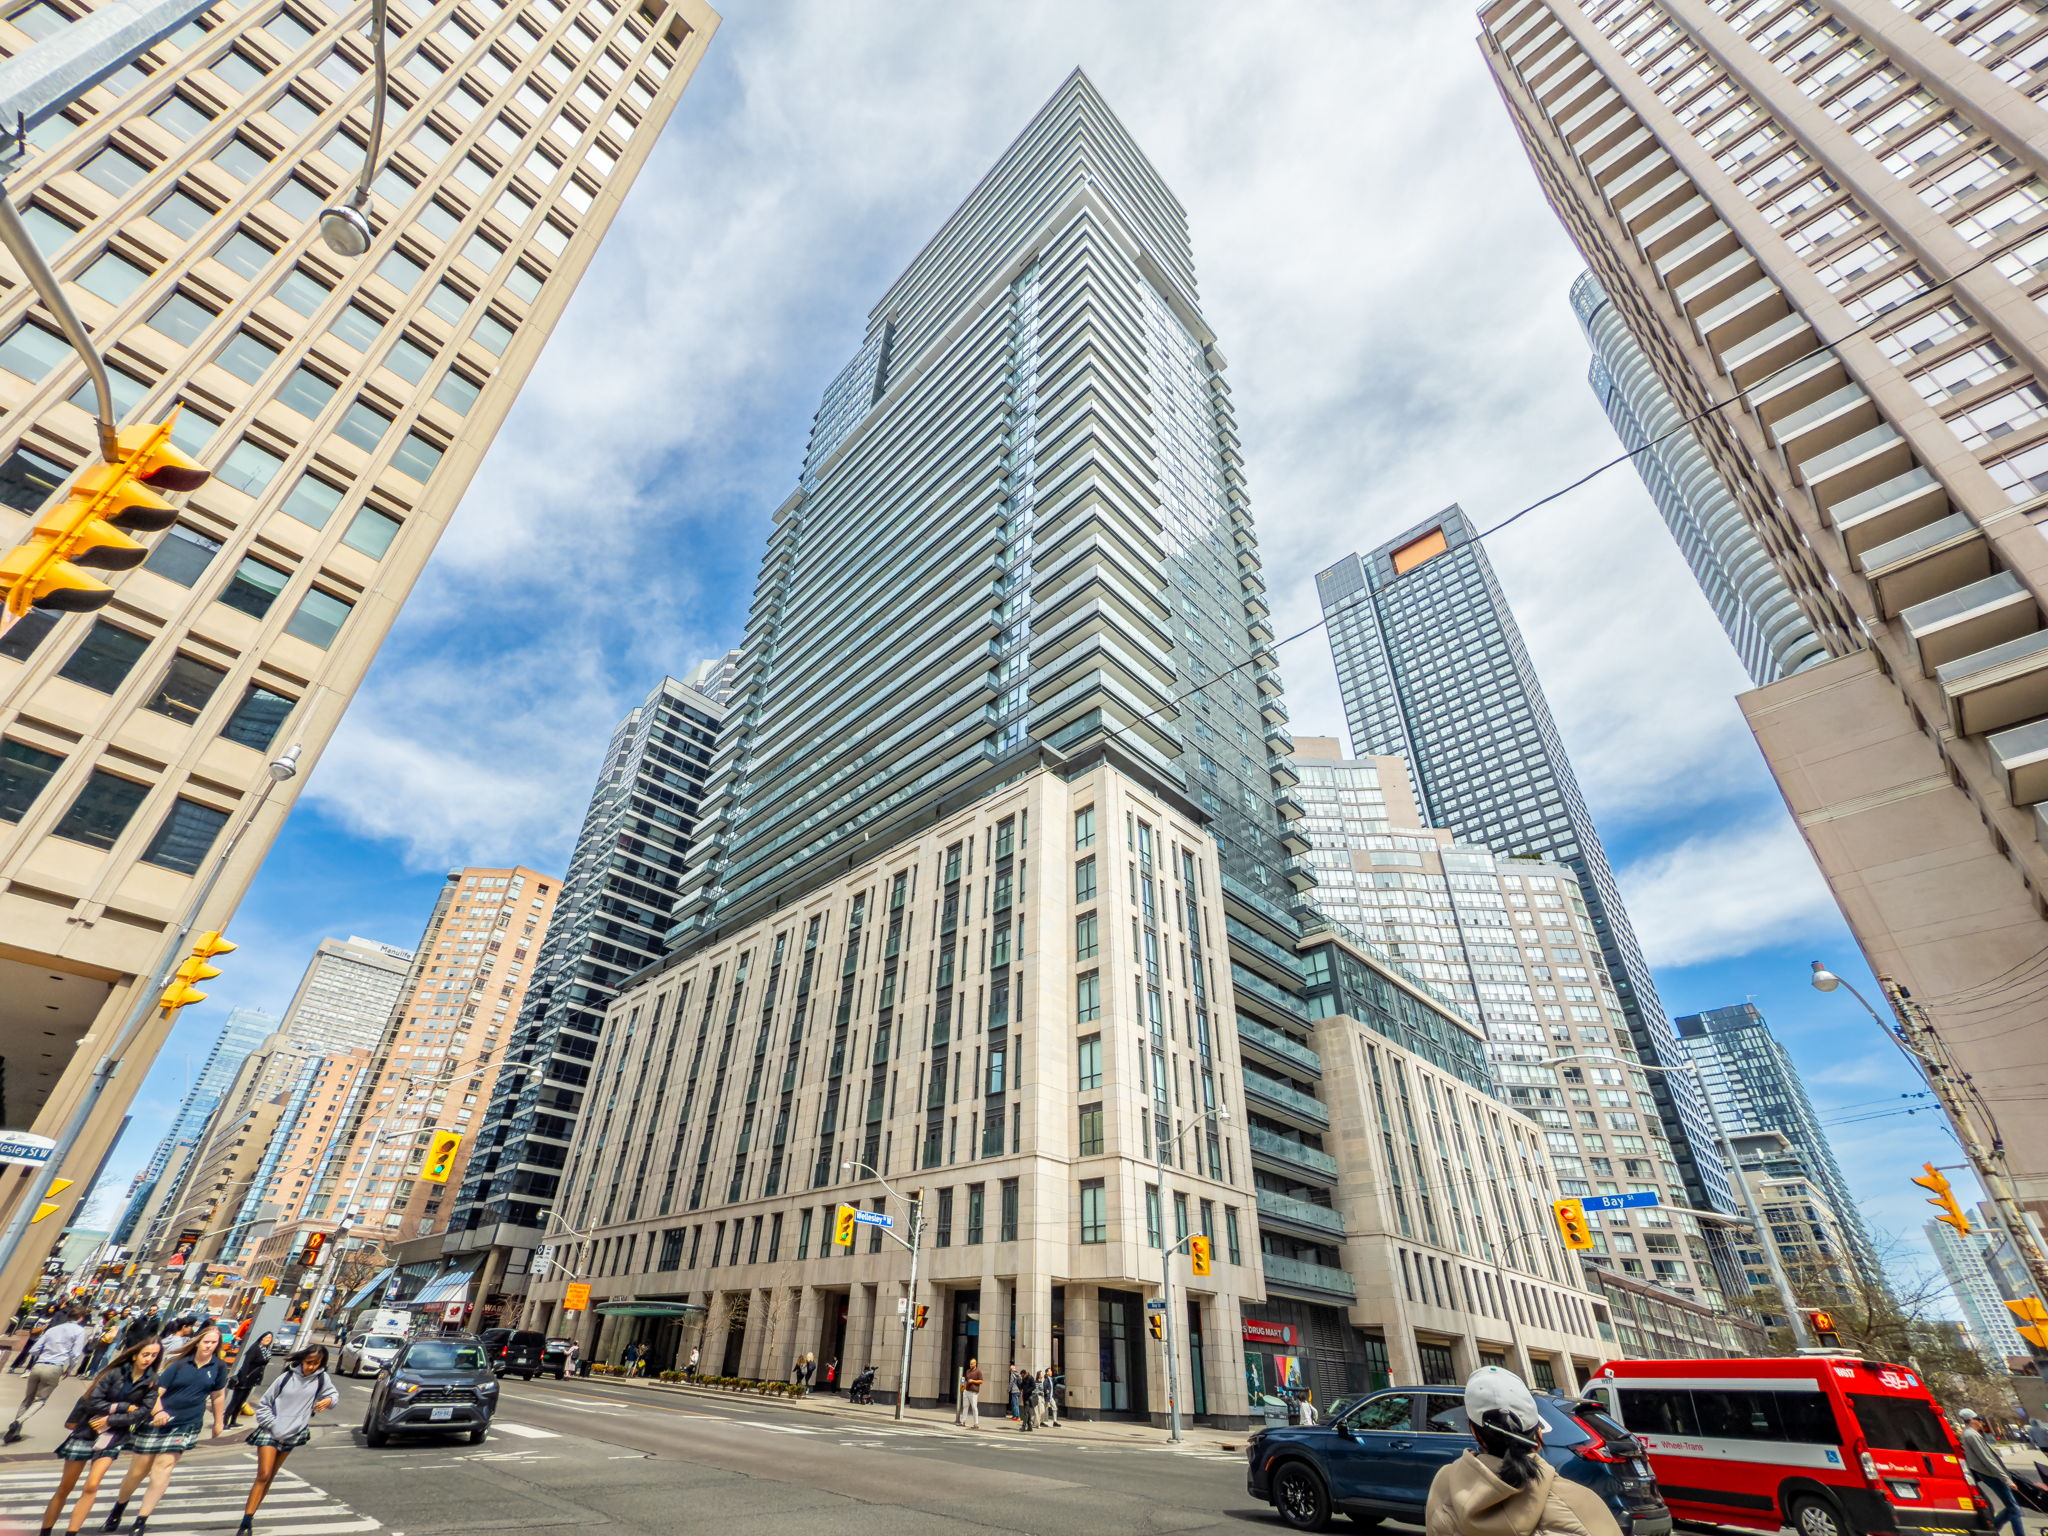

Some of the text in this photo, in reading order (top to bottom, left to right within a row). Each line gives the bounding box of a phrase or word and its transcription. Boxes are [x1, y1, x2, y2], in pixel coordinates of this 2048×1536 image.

[380, 945, 411, 959] Manulife
[28, 1147, 39, 1157] St
[39, 1148, 50, 1158] W
[1602, 1196, 1625, 1208] Bay
[856, 1210, 882, 1224] Wellesley
[1248, 1326, 1265, 1336] DRUG
[1265, 1328, 1281, 1337] MART
[1660, 1440, 1704, 1451] Wheel-Trans
